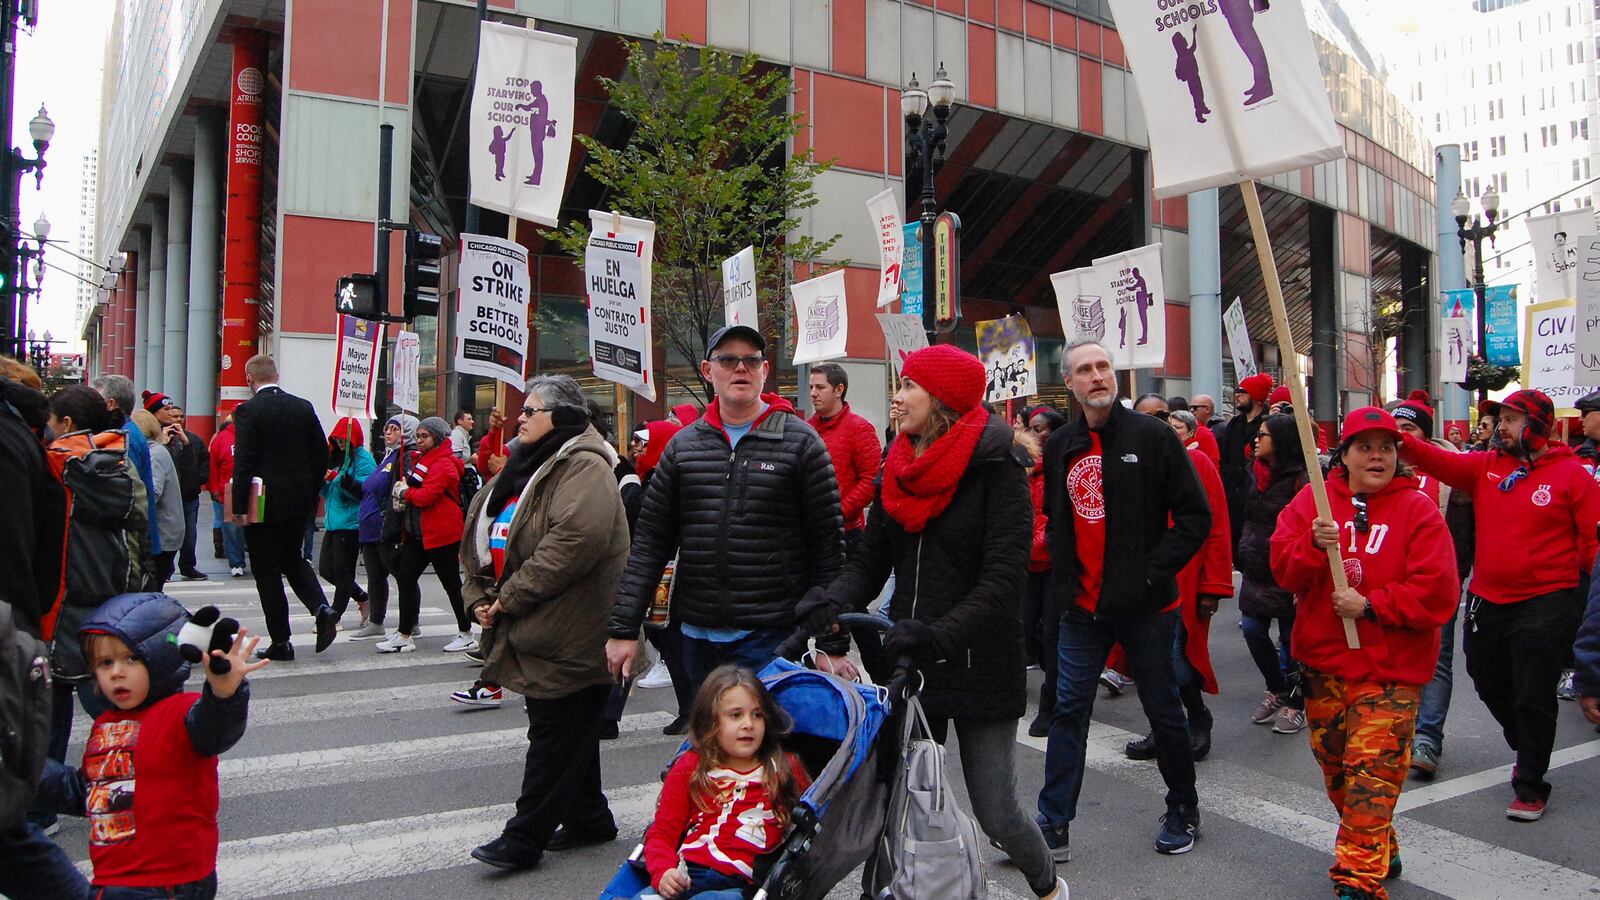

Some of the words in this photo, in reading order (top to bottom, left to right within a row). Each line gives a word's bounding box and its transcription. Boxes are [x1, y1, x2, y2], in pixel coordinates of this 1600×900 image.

[1157, 0, 1184, 10] OU
[1155, 0, 1218, 32] SCHOOLS
[505, 77, 530, 88] STOP
[237, 94, 263, 102] ATRIUM
[487, 87, 531, 101] STARVING
[493, 101, 514, 112] OUR
[487, 112, 529, 126] SCHOOLS
[236, 123, 263, 135] FOOD
[236, 135, 263, 143] COURT
[235, 149, 263, 160] SHOPS
[470, 242, 498, 252] CHICAGO
[591, 238, 606, 247] CHICAGO
[606, 241, 618, 249] PUBLIC
[618, 243, 636, 251] SCHOOLS
[492, 260, 513, 281] ON
[605, 259, 620, 277] EN
[1555, 260, 1576, 273] Scho
[472, 275, 523, 304] STRIKE
[592, 275, 636, 300] HUELGA
[725, 280, 752, 307] STUDENTS
[477, 306, 519, 328] BETTER
[594, 307, 636, 326] CONTRATO
[469, 320, 523, 345] SCHOOLS
[605, 322, 629, 337] JUSTO
[1538, 315, 1575, 336] CIVI
[347, 347, 369, 361] Mayor
[1545, 343, 1575, 356] CLAS
[341, 360, 370, 375] Lightfoot
[341, 378, 351, 387] Our
[339, 388, 351, 399] Your
[352, 391, 367, 401] Watch
[760, 462, 775, 471] Rab
[1344, 521, 1389, 554] TU
